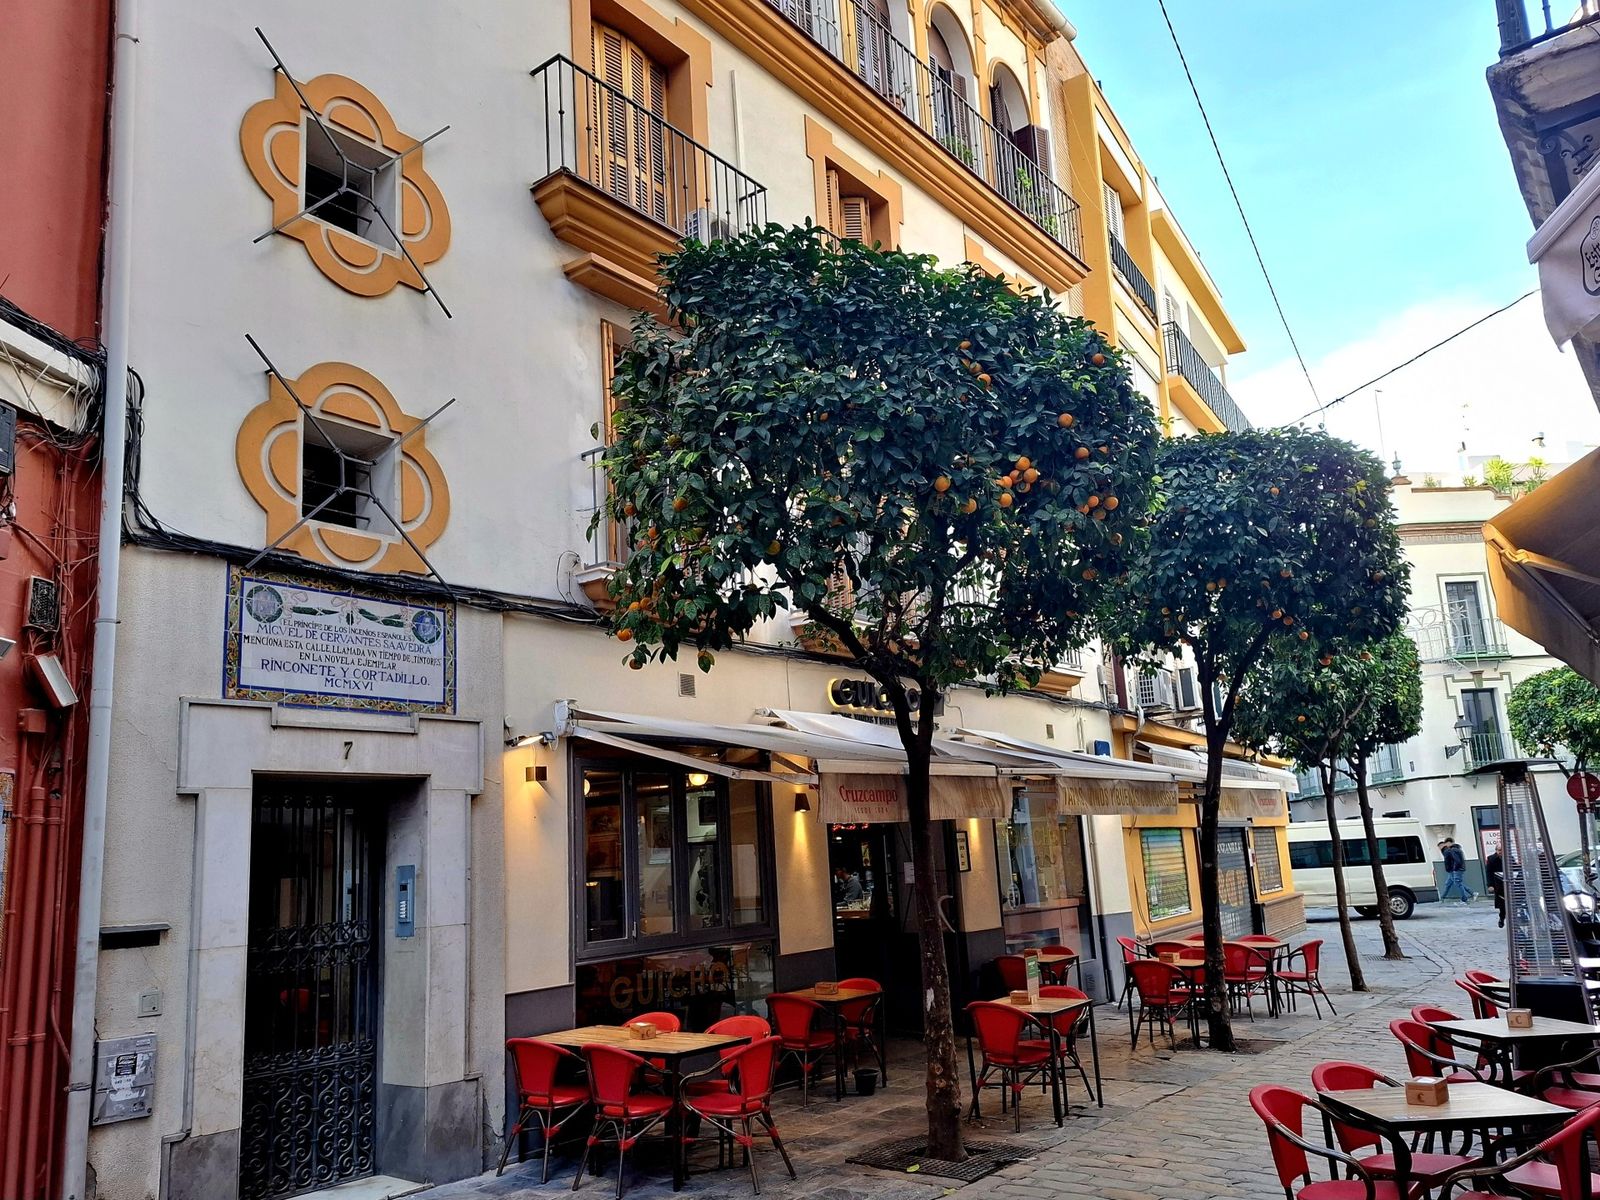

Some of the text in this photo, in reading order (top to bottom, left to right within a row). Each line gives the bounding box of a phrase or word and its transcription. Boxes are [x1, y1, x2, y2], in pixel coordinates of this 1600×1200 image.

[323, 624, 333, 632] DE
[334, 625, 347, 634] LOS
[243, 634, 282, 648] MENCIONA
[284, 640, 303, 650] ESTA
[332, 645, 366, 657] LLAMADA
[367, 650, 378, 658] VN
[379, 650, 402, 661] TIEMPO
[305, 629, 318, 640] DE
[320, 631, 381, 648] CERVANTES
[383, 639, 432, 655] SAAVEDRA
[261, 657, 336, 677] RINCONETE
[341, 667, 350, 678] Y
[299, 651, 397, 670] EN LA NOVELA EJEMPLAR
[324, 677, 374, 691] MCMXVI
[344, 741, 353, 760] 7
[839, 785, 898, 804] Cruzcampo
[609, 961, 729, 1009] GUICHO
